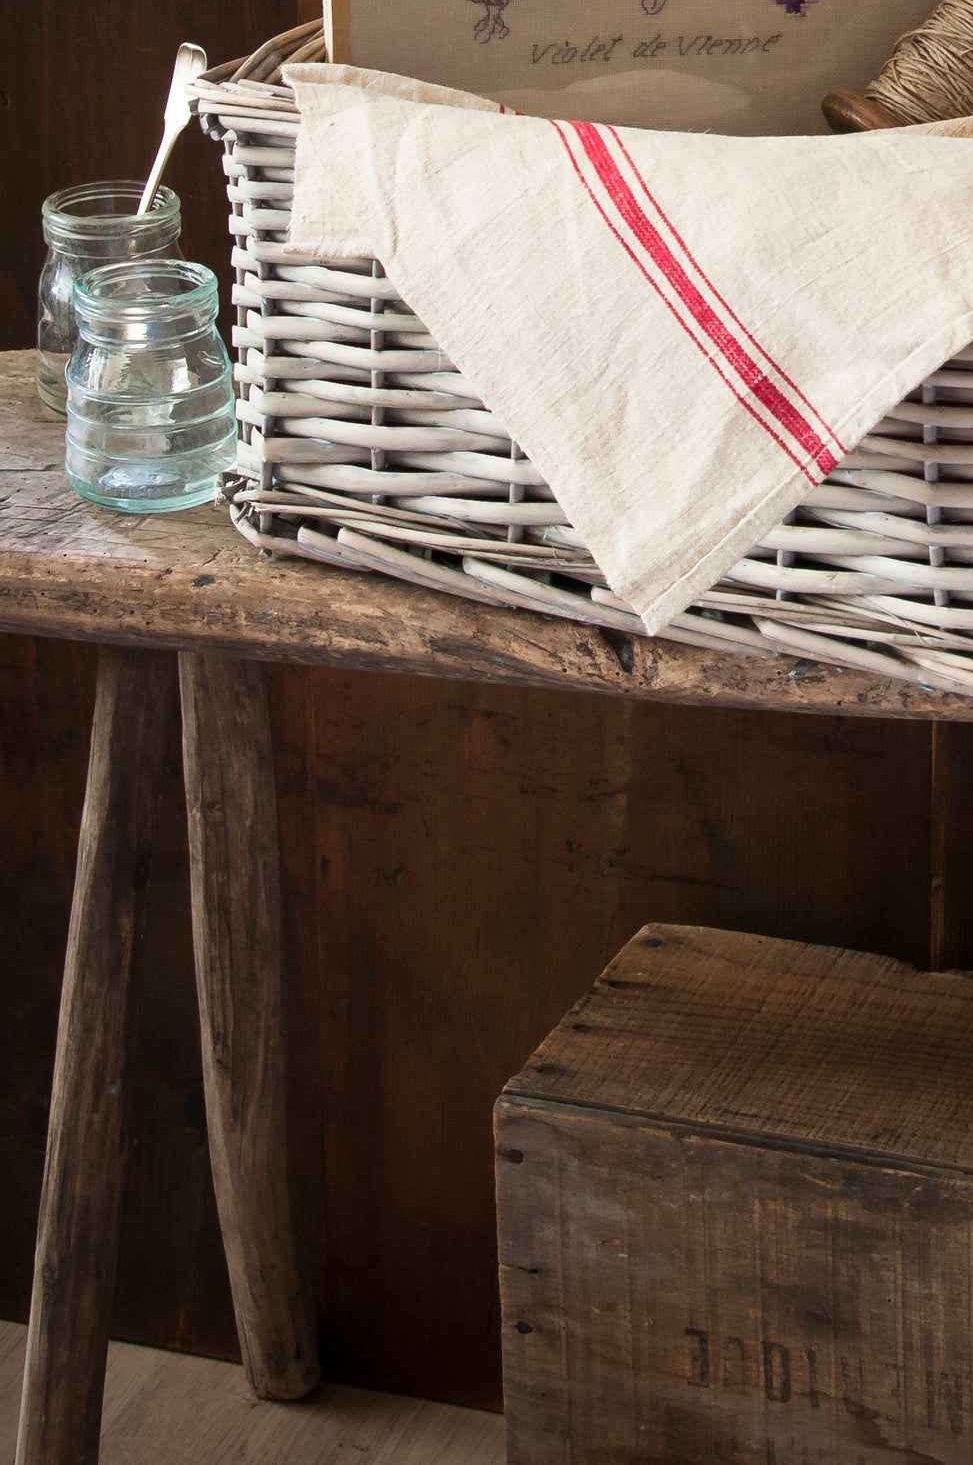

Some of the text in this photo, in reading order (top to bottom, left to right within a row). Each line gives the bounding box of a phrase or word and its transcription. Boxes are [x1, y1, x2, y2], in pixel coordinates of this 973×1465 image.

[530, 31, 783, 65] Violet de Vienne
